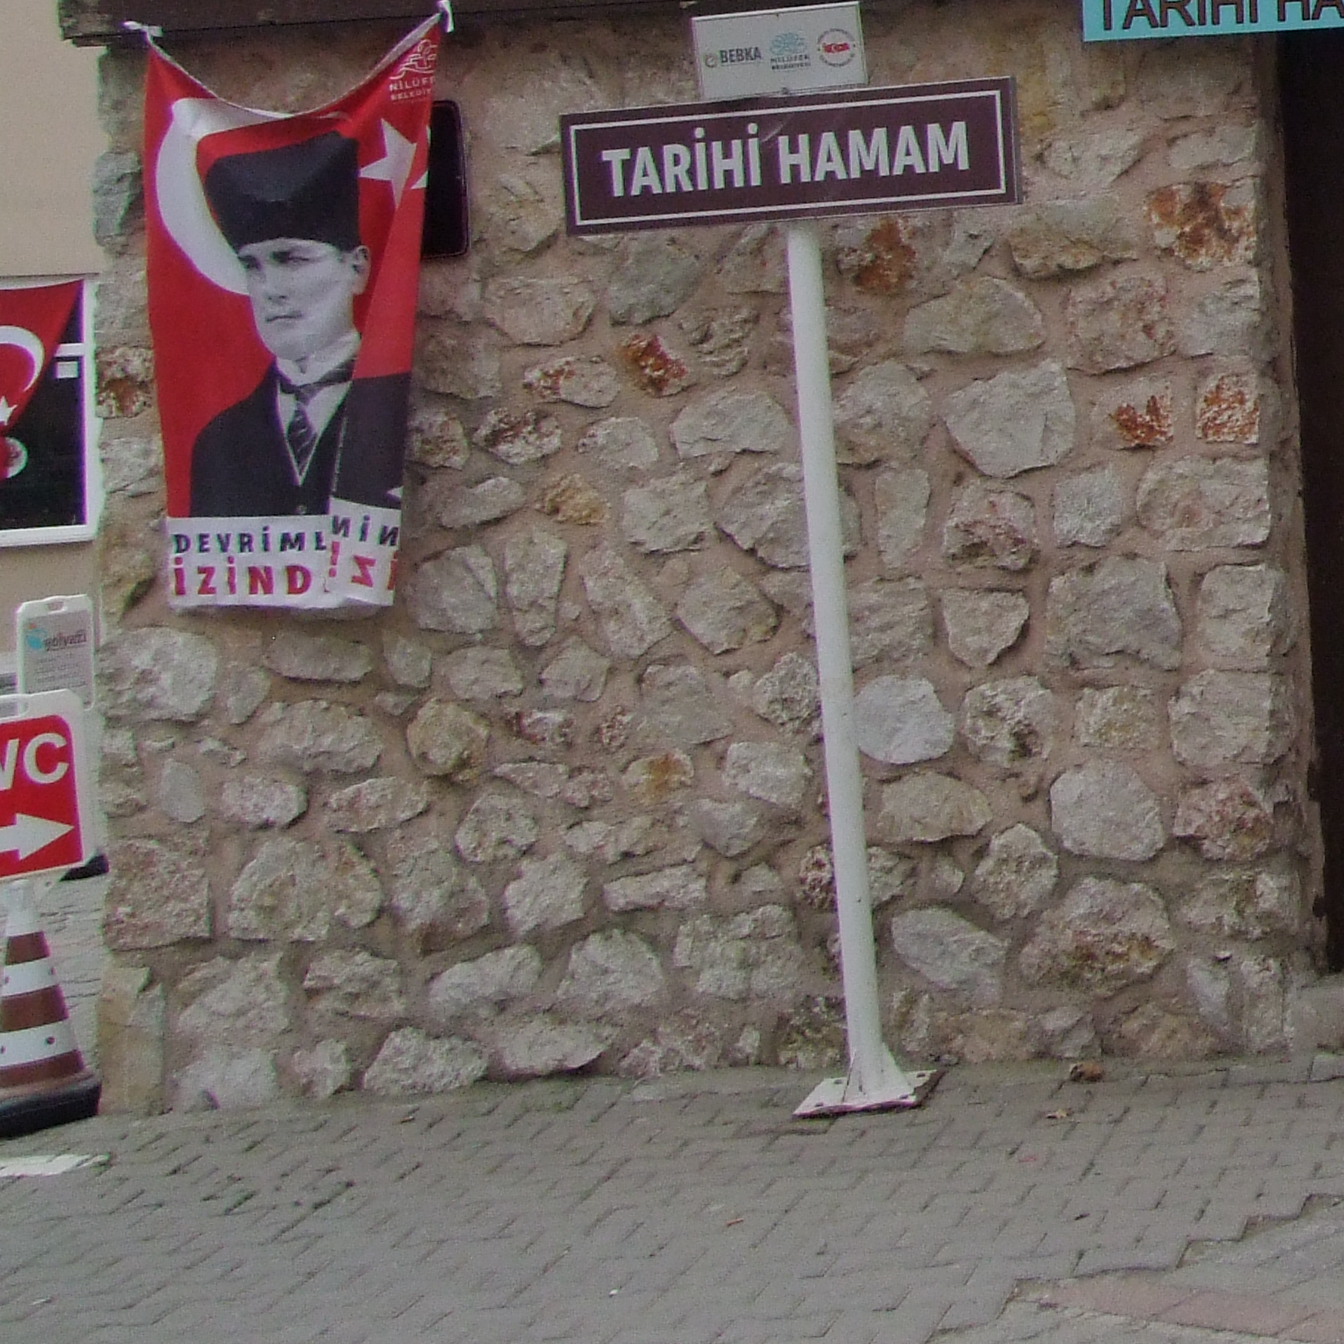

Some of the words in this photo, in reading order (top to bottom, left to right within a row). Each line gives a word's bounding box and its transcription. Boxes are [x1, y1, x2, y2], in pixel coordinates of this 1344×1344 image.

[719, 47, 762, 64] BEBKA
[602, 122, 763, 197] TARİHİ
[778, 121, 969, 184] HAMAM
[174, 556, 330, 596] İZİND
